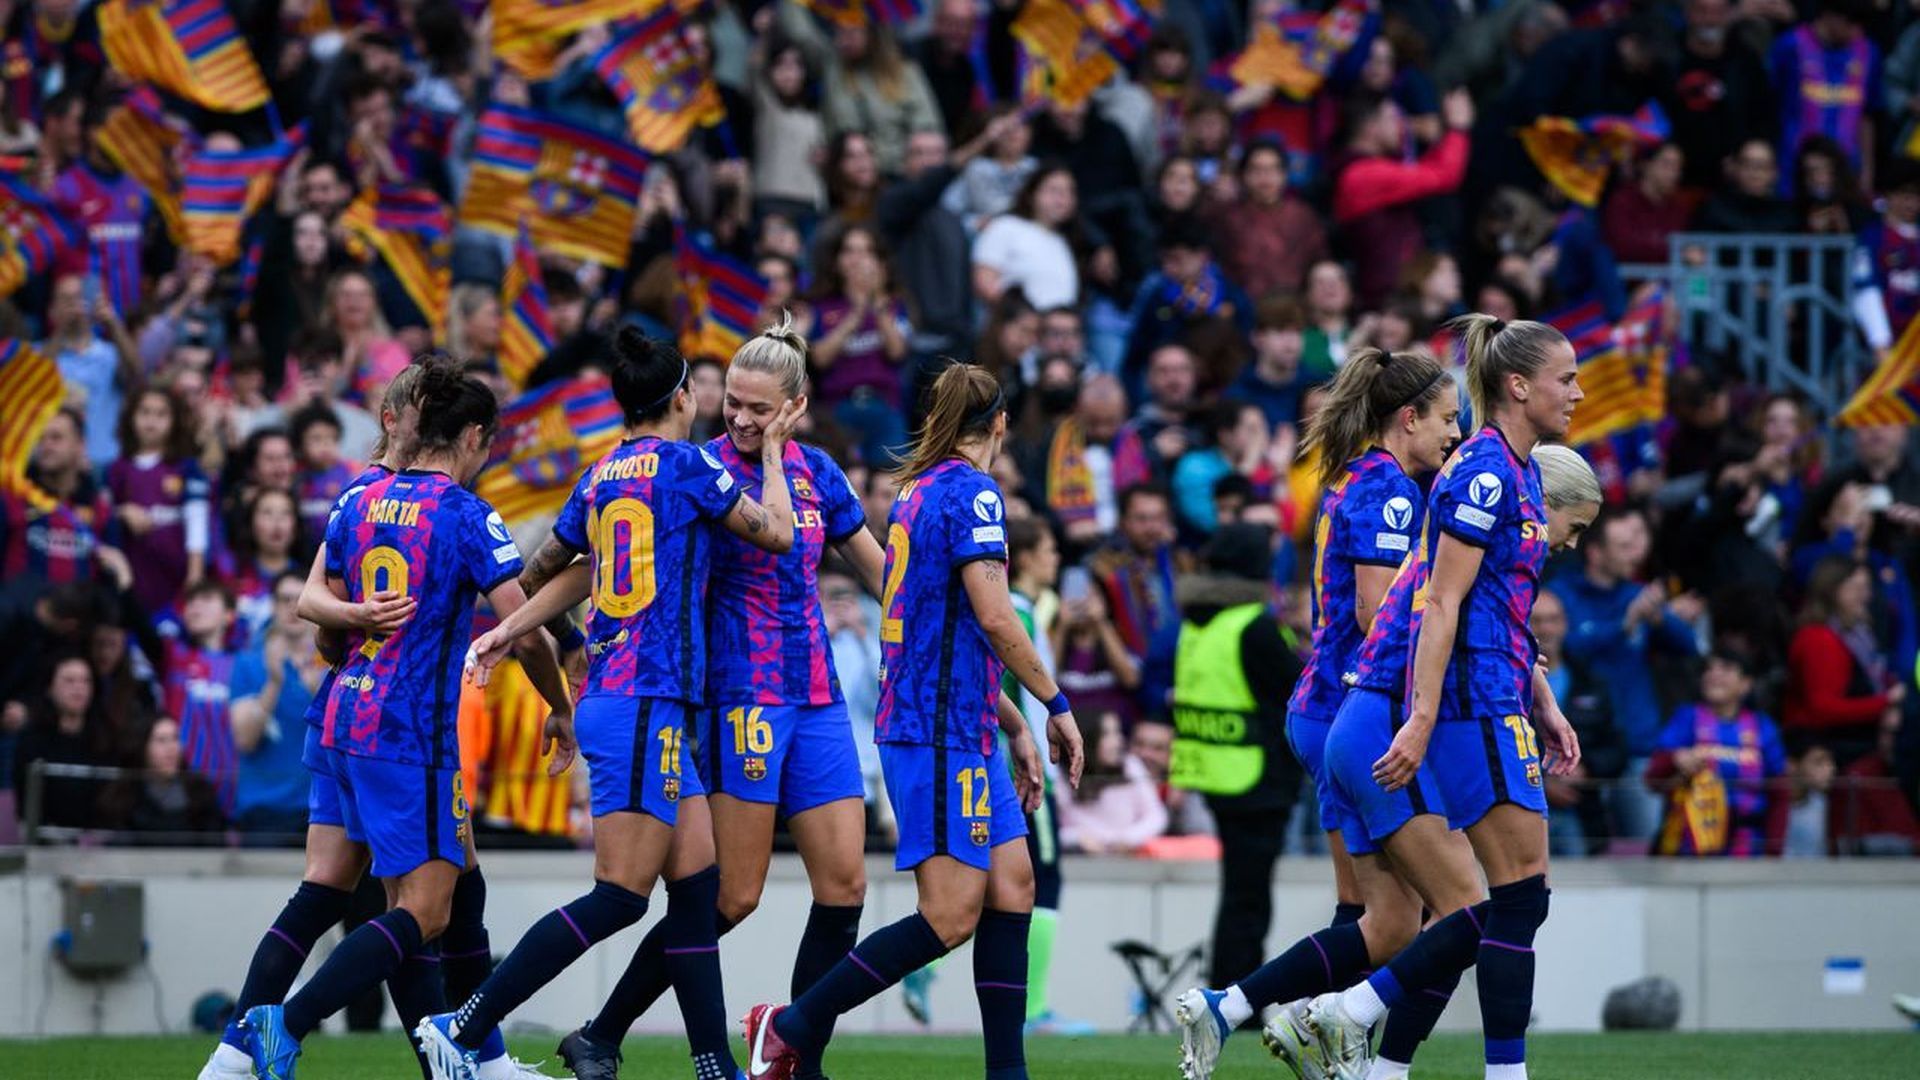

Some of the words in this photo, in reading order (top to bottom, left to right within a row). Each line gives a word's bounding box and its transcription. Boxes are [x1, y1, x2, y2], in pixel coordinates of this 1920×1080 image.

[365, 497, 422, 527] MARTA
[727, 706, 774, 755] 16
[956, 766, 992, 818] 12
